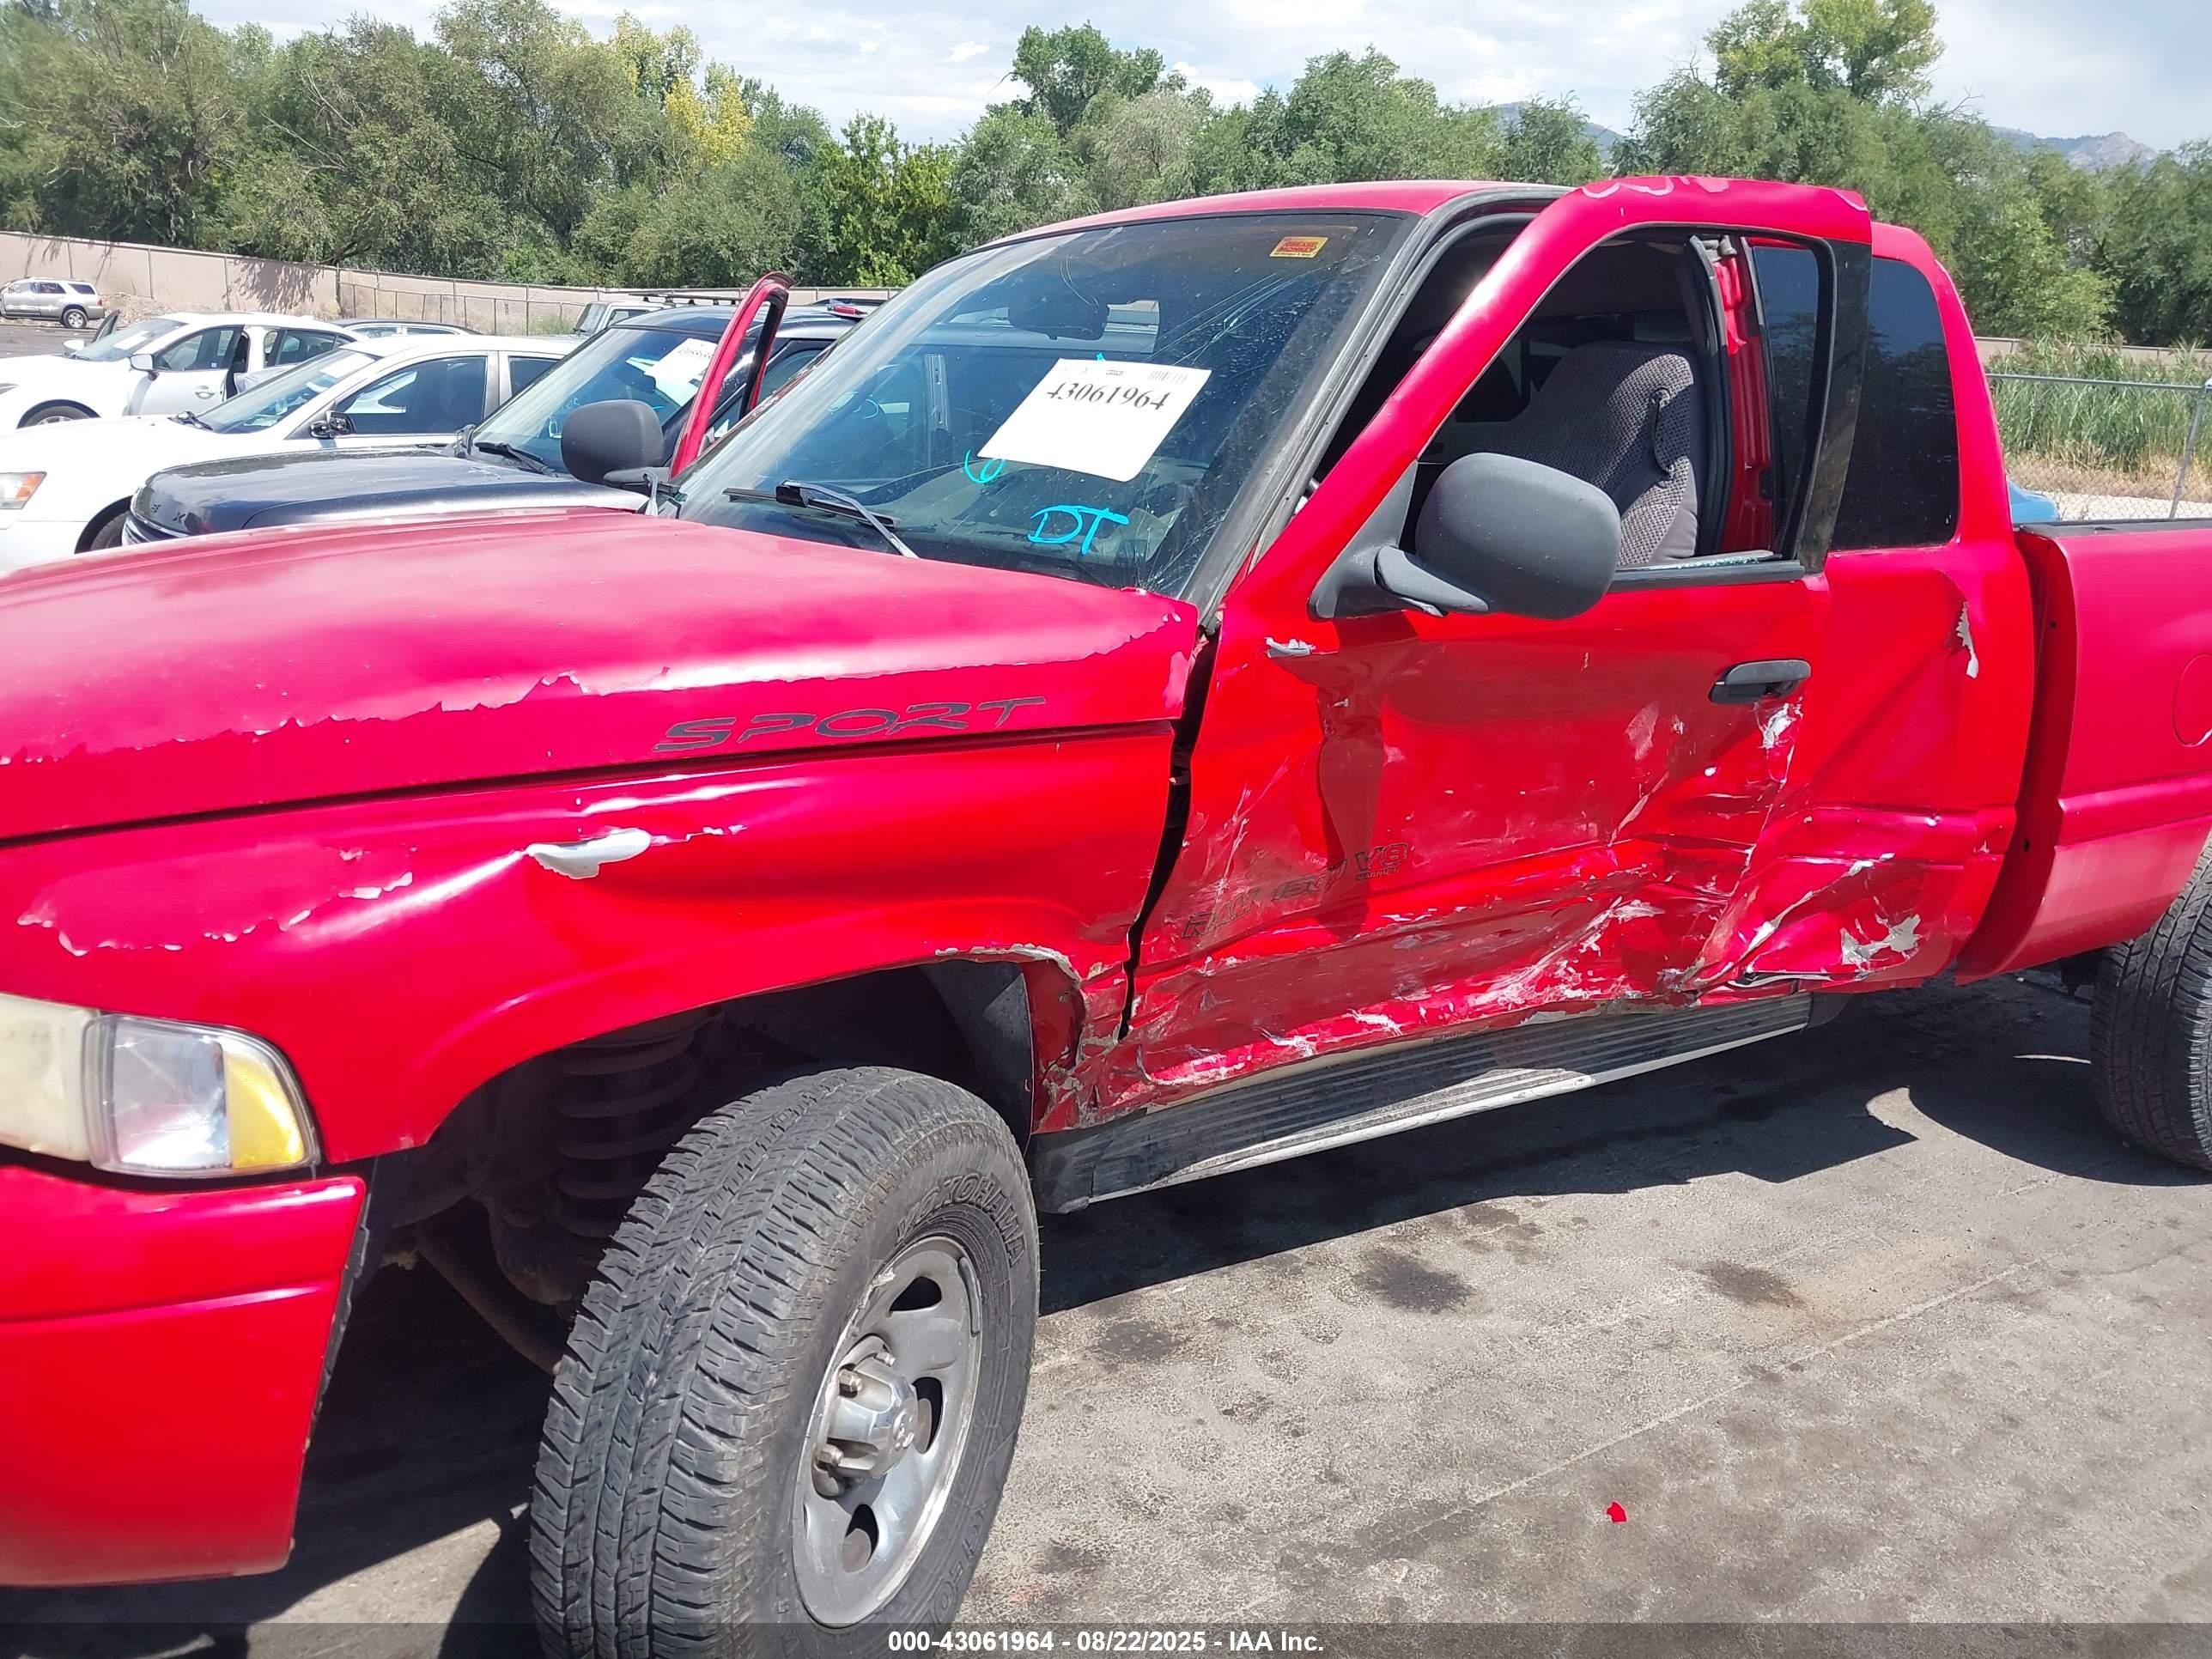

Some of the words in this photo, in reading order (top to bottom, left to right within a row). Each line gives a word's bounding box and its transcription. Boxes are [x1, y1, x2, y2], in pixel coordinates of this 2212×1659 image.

[1047, 381, 1171, 410] 43061964
[1027, 504, 1130, 556] DT
[652, 696, 1046, 752] SPORT
[1354, 842, 1409, 872] V8
